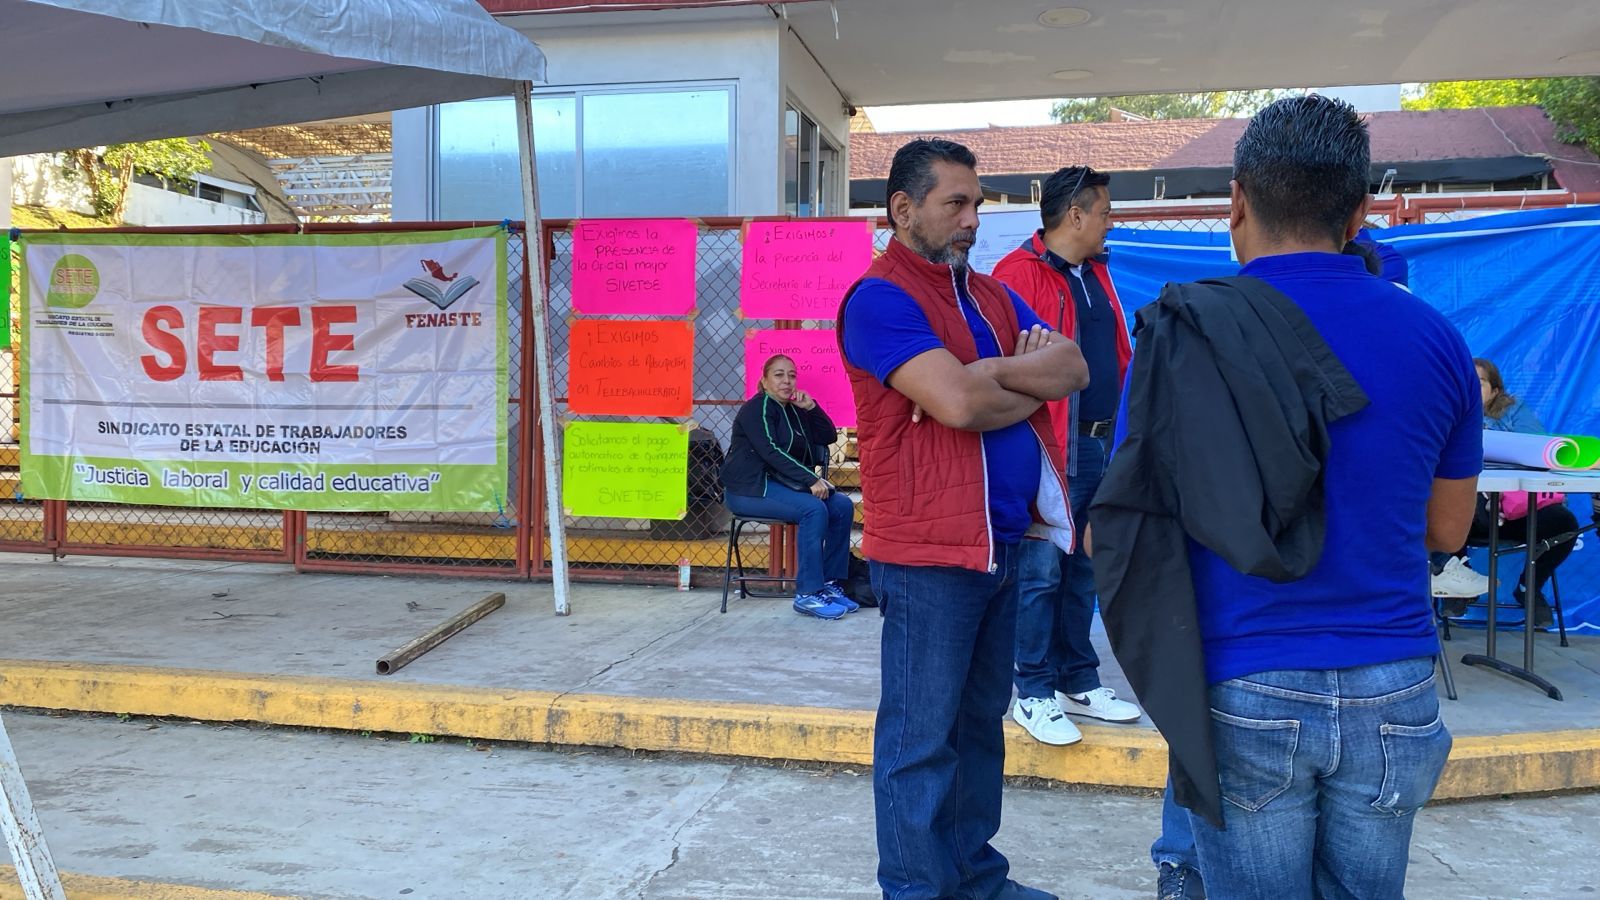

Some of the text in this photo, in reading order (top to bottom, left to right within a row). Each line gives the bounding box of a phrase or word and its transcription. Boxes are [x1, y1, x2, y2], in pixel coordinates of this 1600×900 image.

[646, 228, 659, 240] la
[755, 248, 766, 264] la
[577, 260, 588, 271] la
[55, 268, 94, 285] SETE
[405, 312, 482, 328] FENASTE
[140, 304, 359, 383] SETE
[98, 421, 408, 439] SINDICATO ESTATAL DE TRABAJADORES
[180, 438, 321, 455] DE LA EDUCACIÓN
[163, 469, 228, 488] laboral
[241, 475, 252, 493] y
[258, 473, 325, 491] calidad
